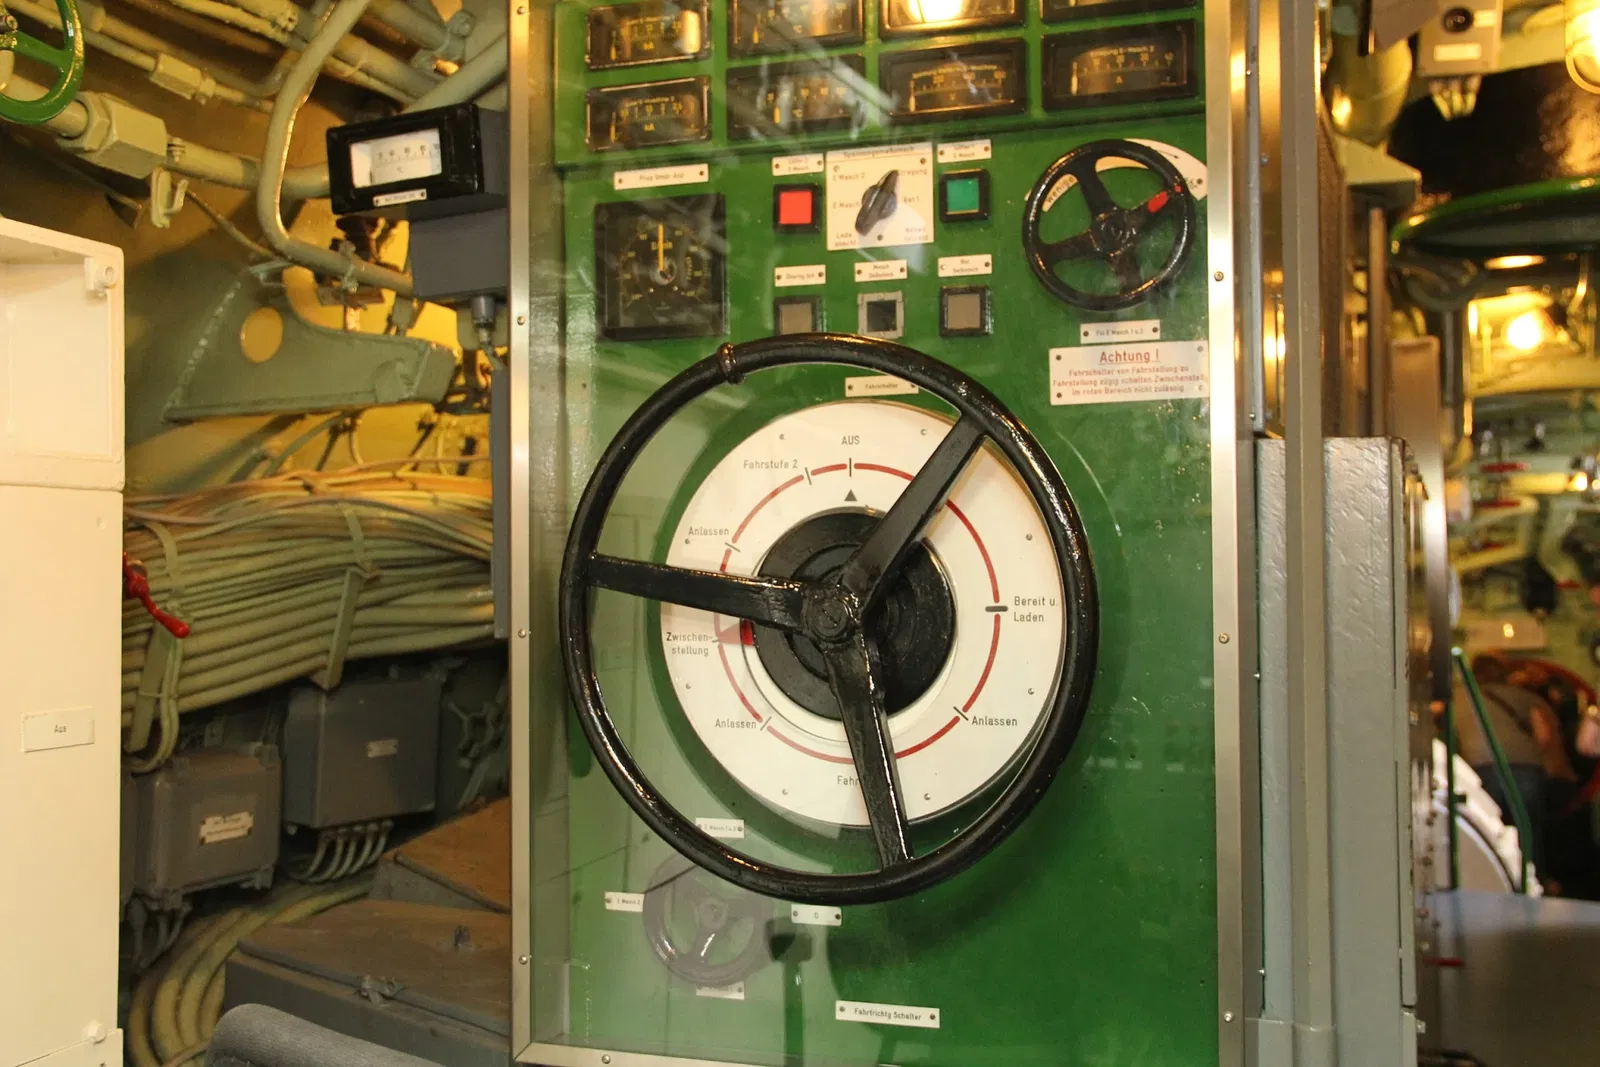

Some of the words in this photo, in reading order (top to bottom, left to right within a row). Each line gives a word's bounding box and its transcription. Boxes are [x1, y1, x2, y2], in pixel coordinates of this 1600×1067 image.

[1100, 350, 1150, 363] Achtung
[841, 435, 860, 445] AUS
[743, 460, 790, 470] Fahrstufe
[792, 459, 798, 469] 2
[688, 527, 730, 536] Anlassen
[1014, 596, 1046, 606] Bereit
[1014, 612, 1045, 622] Laden
[666, 631, 713, 642] Zwischen-
[672, 645, 709, 657] stellung
[715, 718, 757, 730] Anlassen
[971, 716, 1018, 727] Anlassen
[54, 724, 67, 733] Aus
[837, 775, 860, 786] Fahr
[854, 1007, 892, 1020] Fahrtrichtg
[893, 1012, 922, 1022] Schalter
